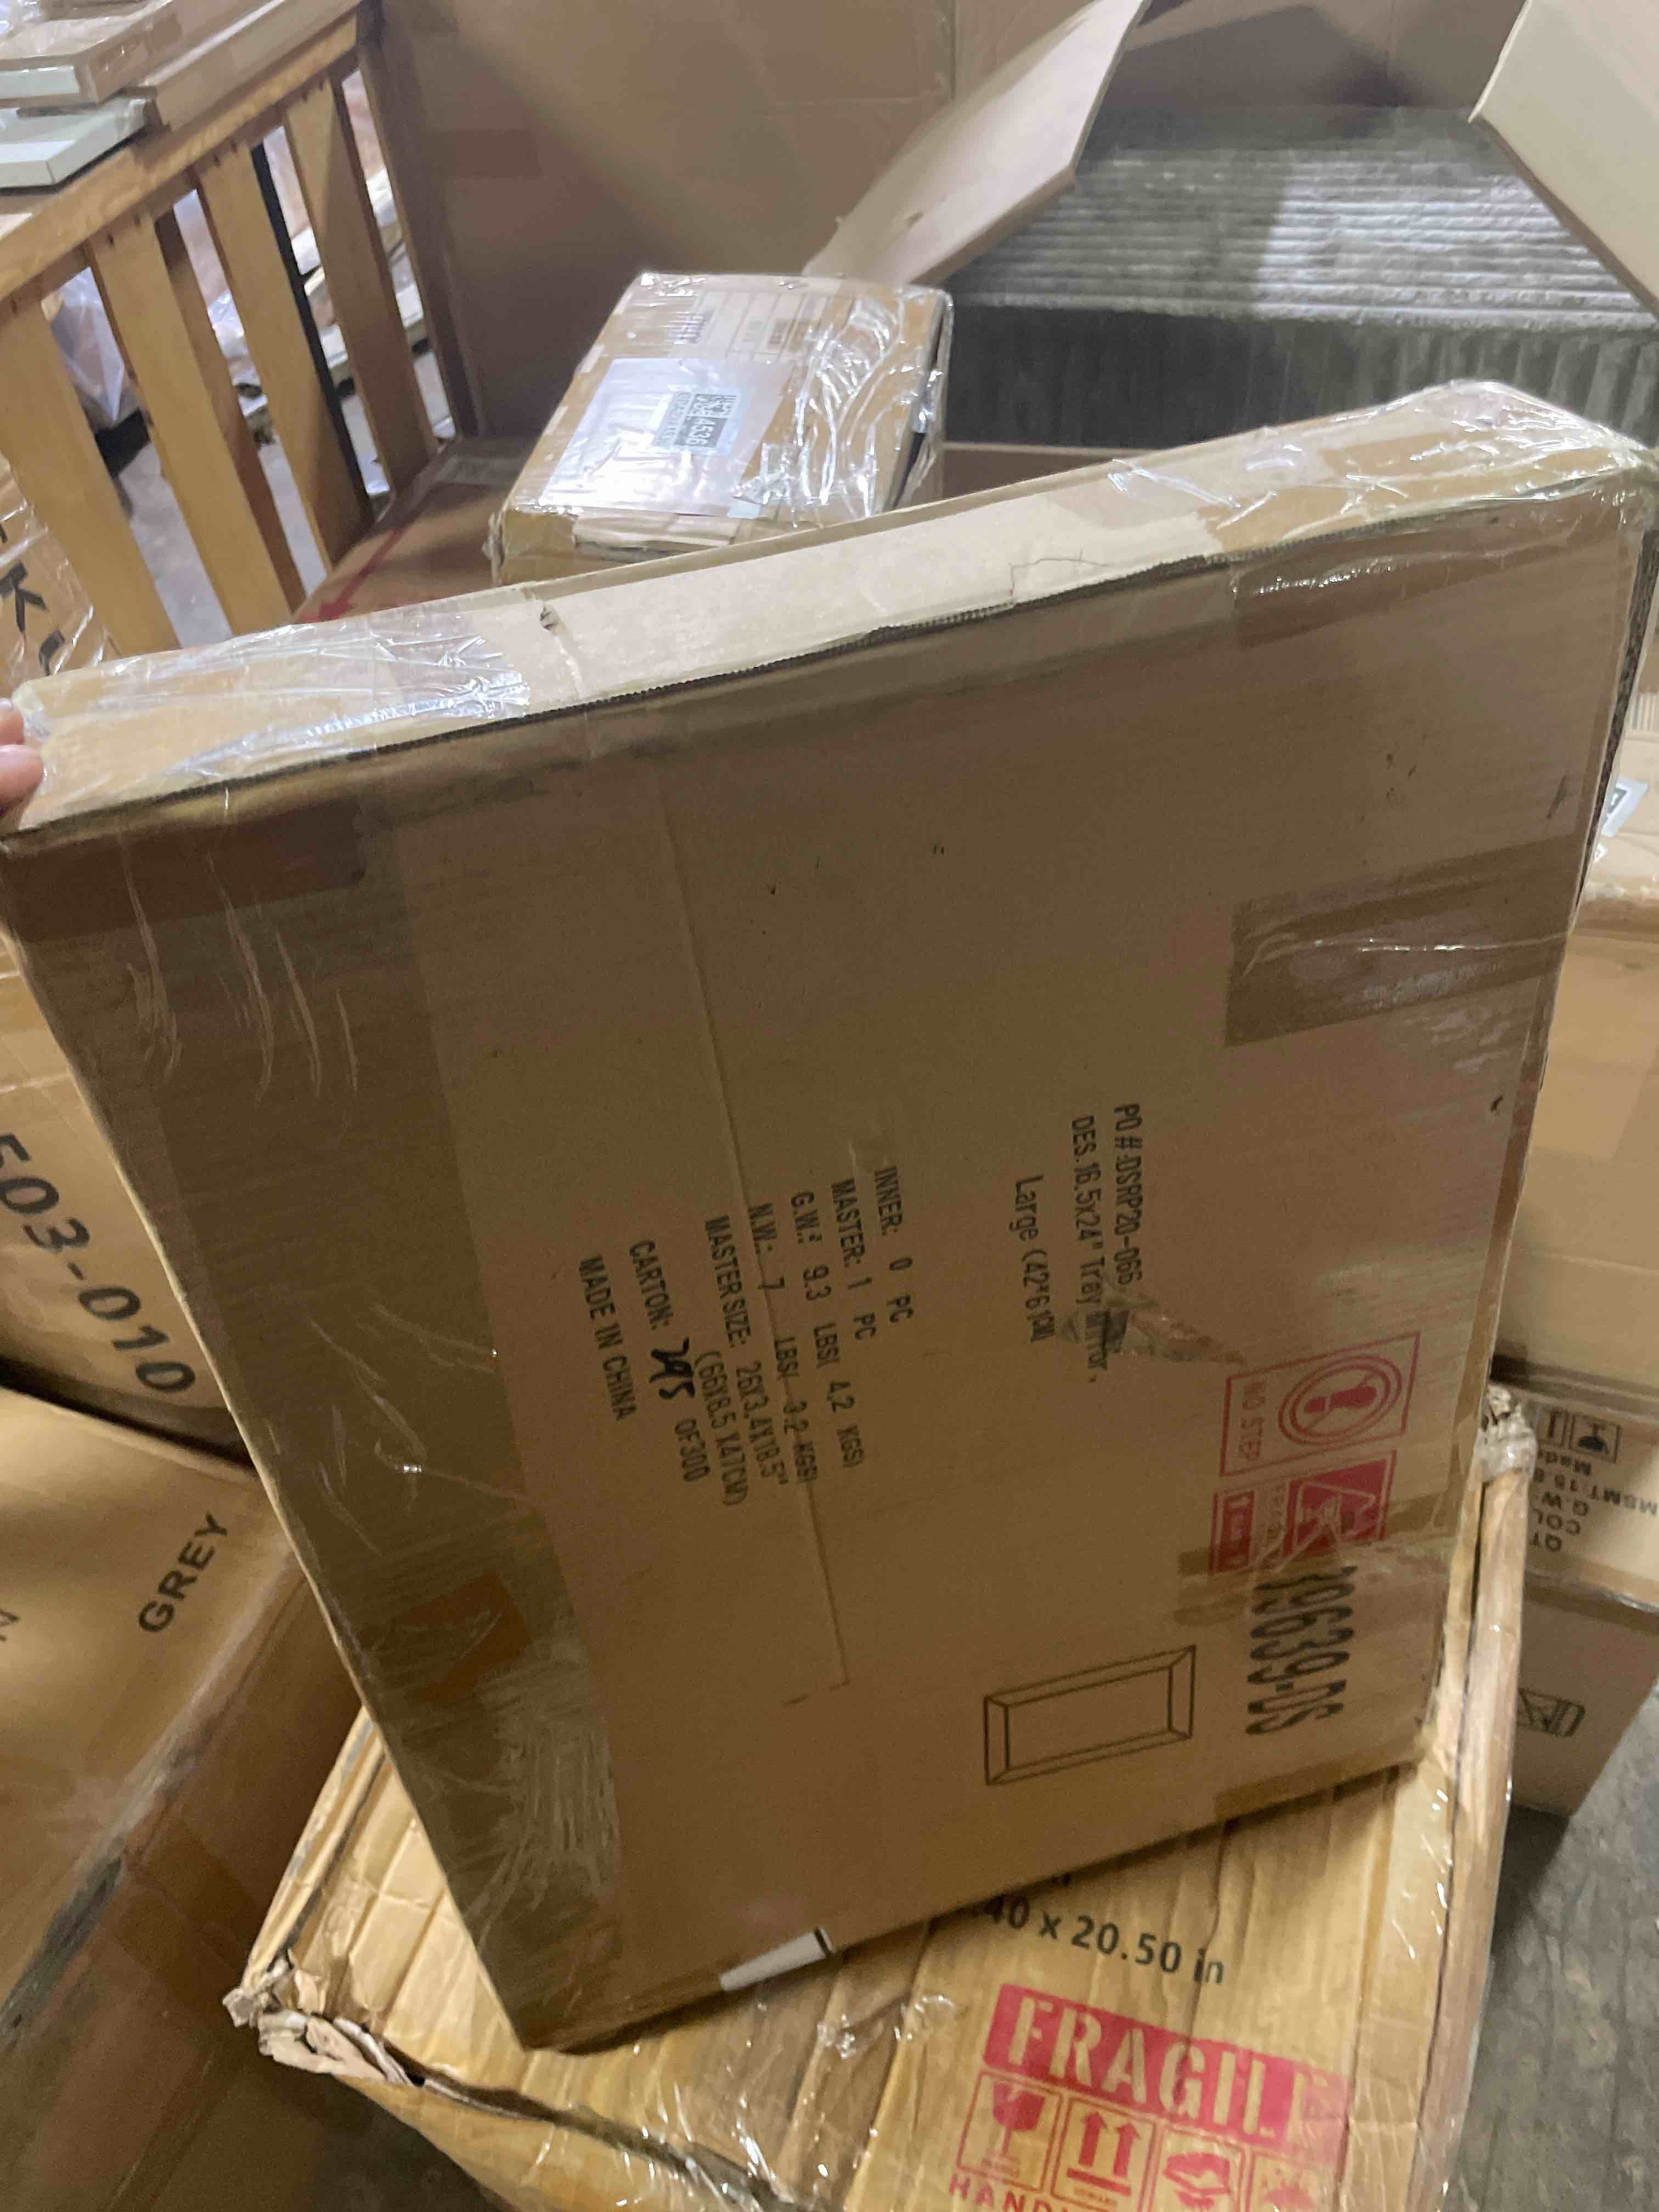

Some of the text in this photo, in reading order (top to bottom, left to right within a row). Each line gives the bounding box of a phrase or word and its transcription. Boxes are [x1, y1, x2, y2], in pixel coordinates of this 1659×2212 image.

[1113, 1102, 1143, 1132] PO
[873, 1164, 915, 1323] INNER: 0 PC
[1008, 1173, 1044, 1242] Large
[629, 1239, 674, 1330] CARTON:
[802, 1263, 832, 1301] 9.3
[830, 1177, 877, 1340] MASTER: 1 PC
[1075, 1255, 1105, 1305] Tray
[578, 1254, 637, 1421] MADE IN CHINA
[757, 1275, 786, 1294] 7
[782, 1400, 809, 1436] 3.2
[138, 1511, 228, 1633] GREY
[1037, 1909, 1063, 1940] x
[1071, 1914, 1182, 1974] 20.50
[1193, 1947, 1224, 1984] in
[949, 2173, 1071, 2212] HAND
